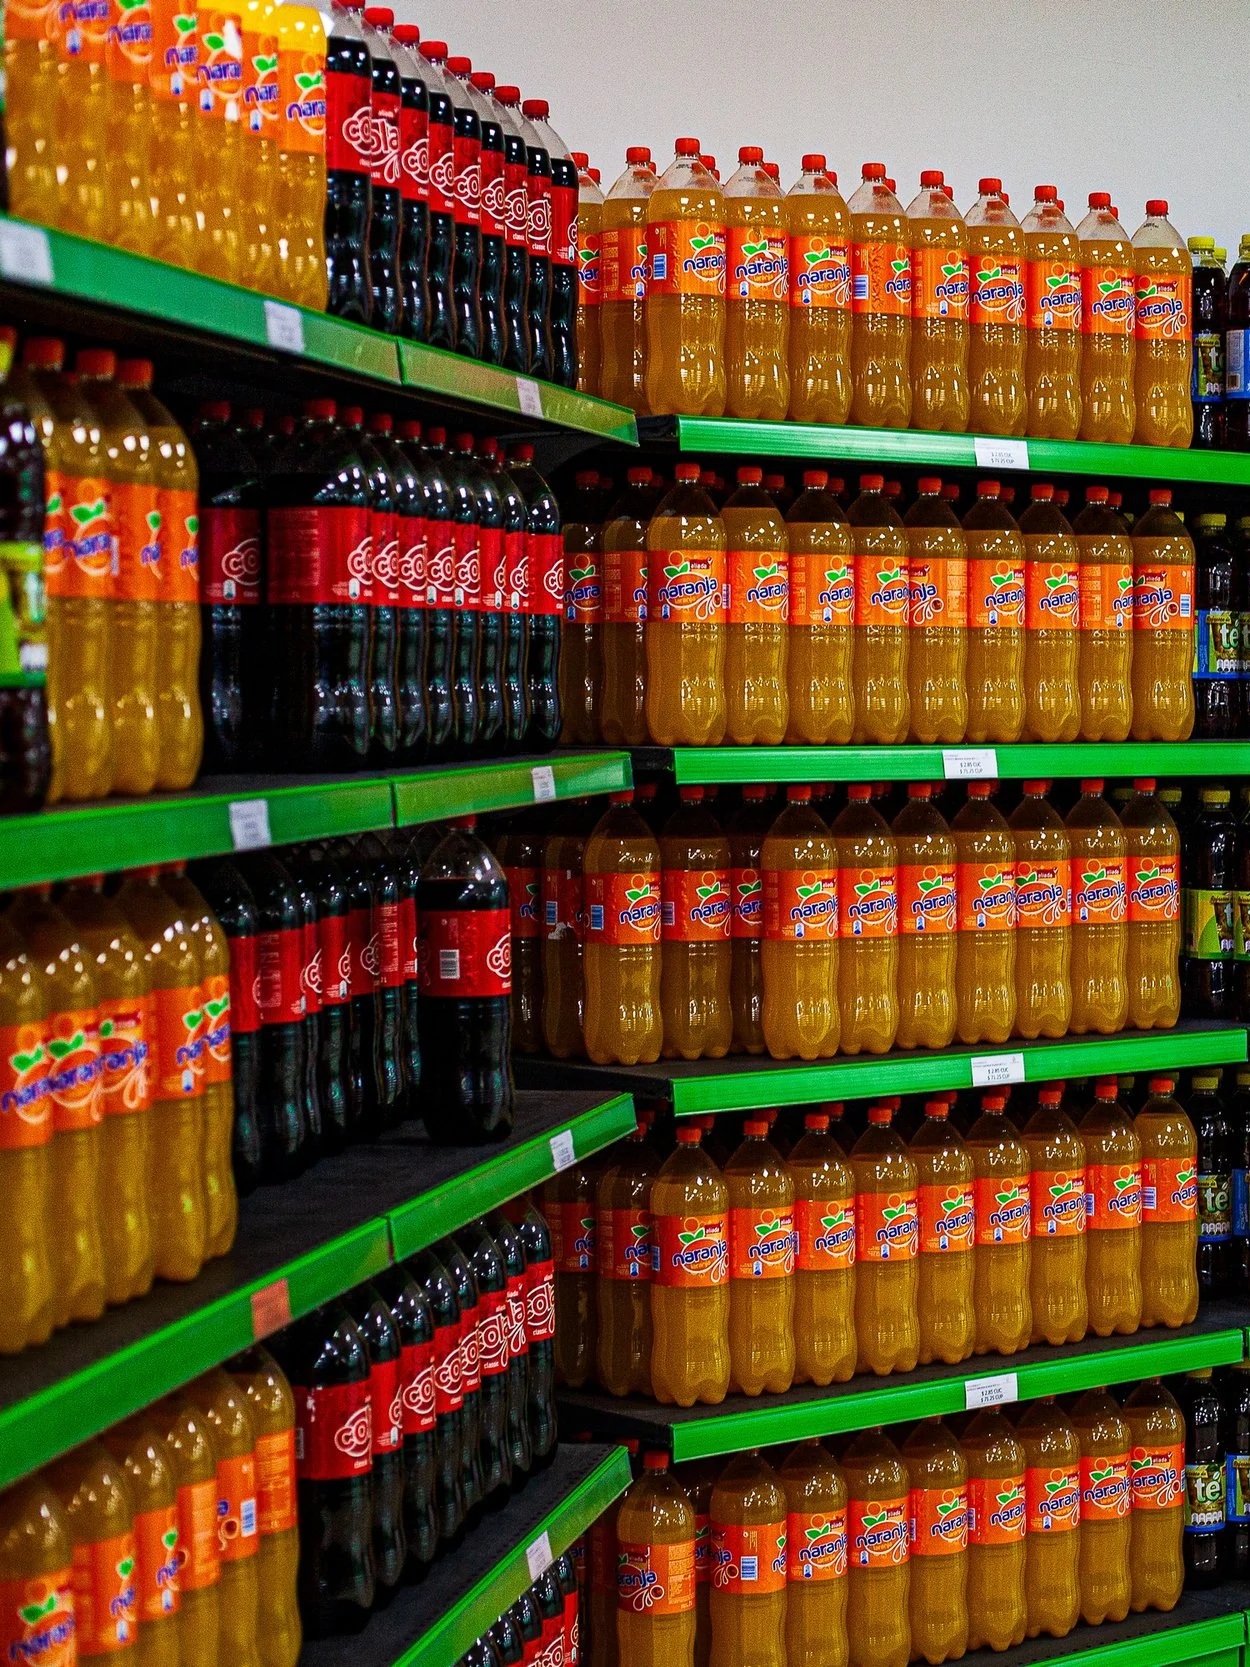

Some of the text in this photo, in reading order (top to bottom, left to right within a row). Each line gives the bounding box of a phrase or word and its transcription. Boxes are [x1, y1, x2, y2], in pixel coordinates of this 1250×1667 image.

[683, 254, 725, 272] naran
[798, 266, 850, 286] naranja
[886, 279, 911, 293] nara
[936, 281, 969, 297] naran
[971, 282, 1023, 303] naranja
[1041, 290, 1081, 308] naranj
[1093, 294, 1135, 314] naranj
[565, 586, 600, 602] nara
[658, 578, 717, 601] naranja
[747, 583, 788, 602] naran
[871, 585, 909, 605] naran
[1077, 881, 1126, 905] naranja
[1131, 880, 1178, 902] naranja
[619, 902, 661, 924] naran
[691, 900, 730, 920] naran
[1109, 1190, 1142, 1210] nara
[1171, 1185, 1197, 1204] nara
[1204, 1182, 1229, 1213] té
[673, 1240, 727, 1266] naranja
[1195, 1472, 1220, 1503] té
[991, 1502, 1026, 1525] naran
[931, 1513, 967, 1535] naran
[856, 1522, 907, 1547] naranja
[617, 1570, 657, 1585] aranja
